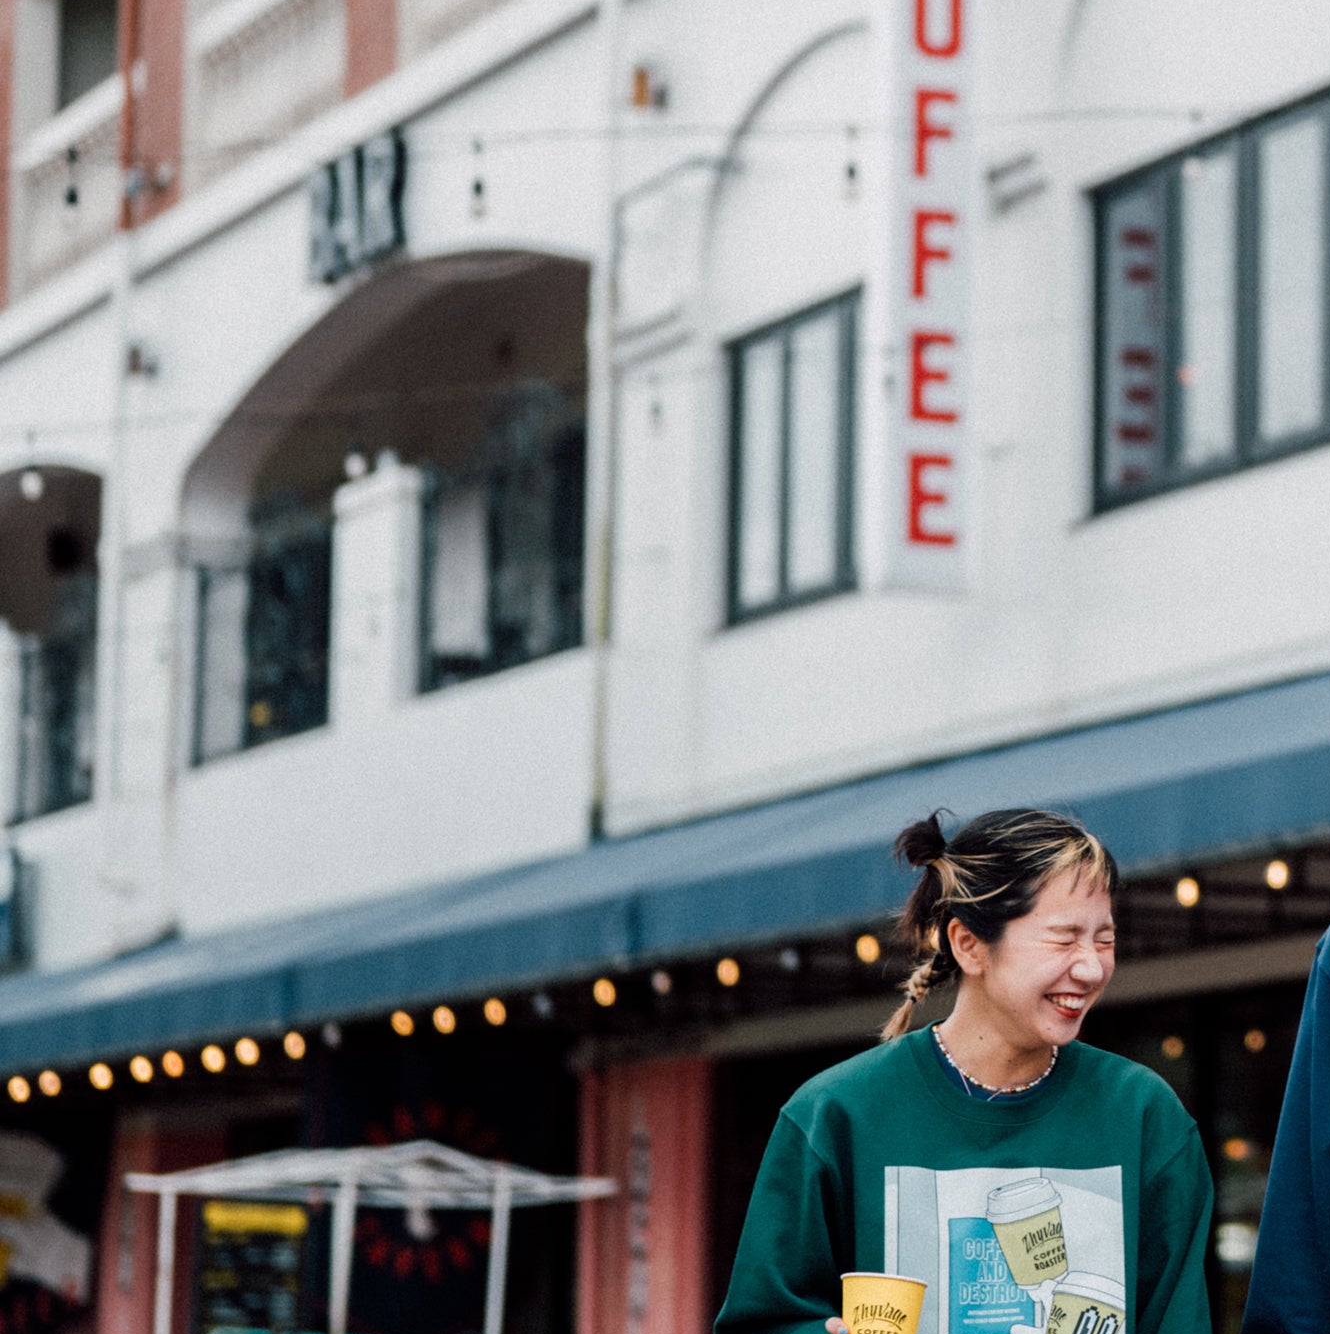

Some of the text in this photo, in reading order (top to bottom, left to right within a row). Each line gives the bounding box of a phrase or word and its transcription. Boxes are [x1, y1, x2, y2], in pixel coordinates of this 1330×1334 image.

[1021, 1221, 1062, 1254] Zhyvag
[963, 1238, 1003, 1260] COFF
[976, 1260, 1008, 1282] AND
[1034, 1254, 1066, 1271] ROASTER
